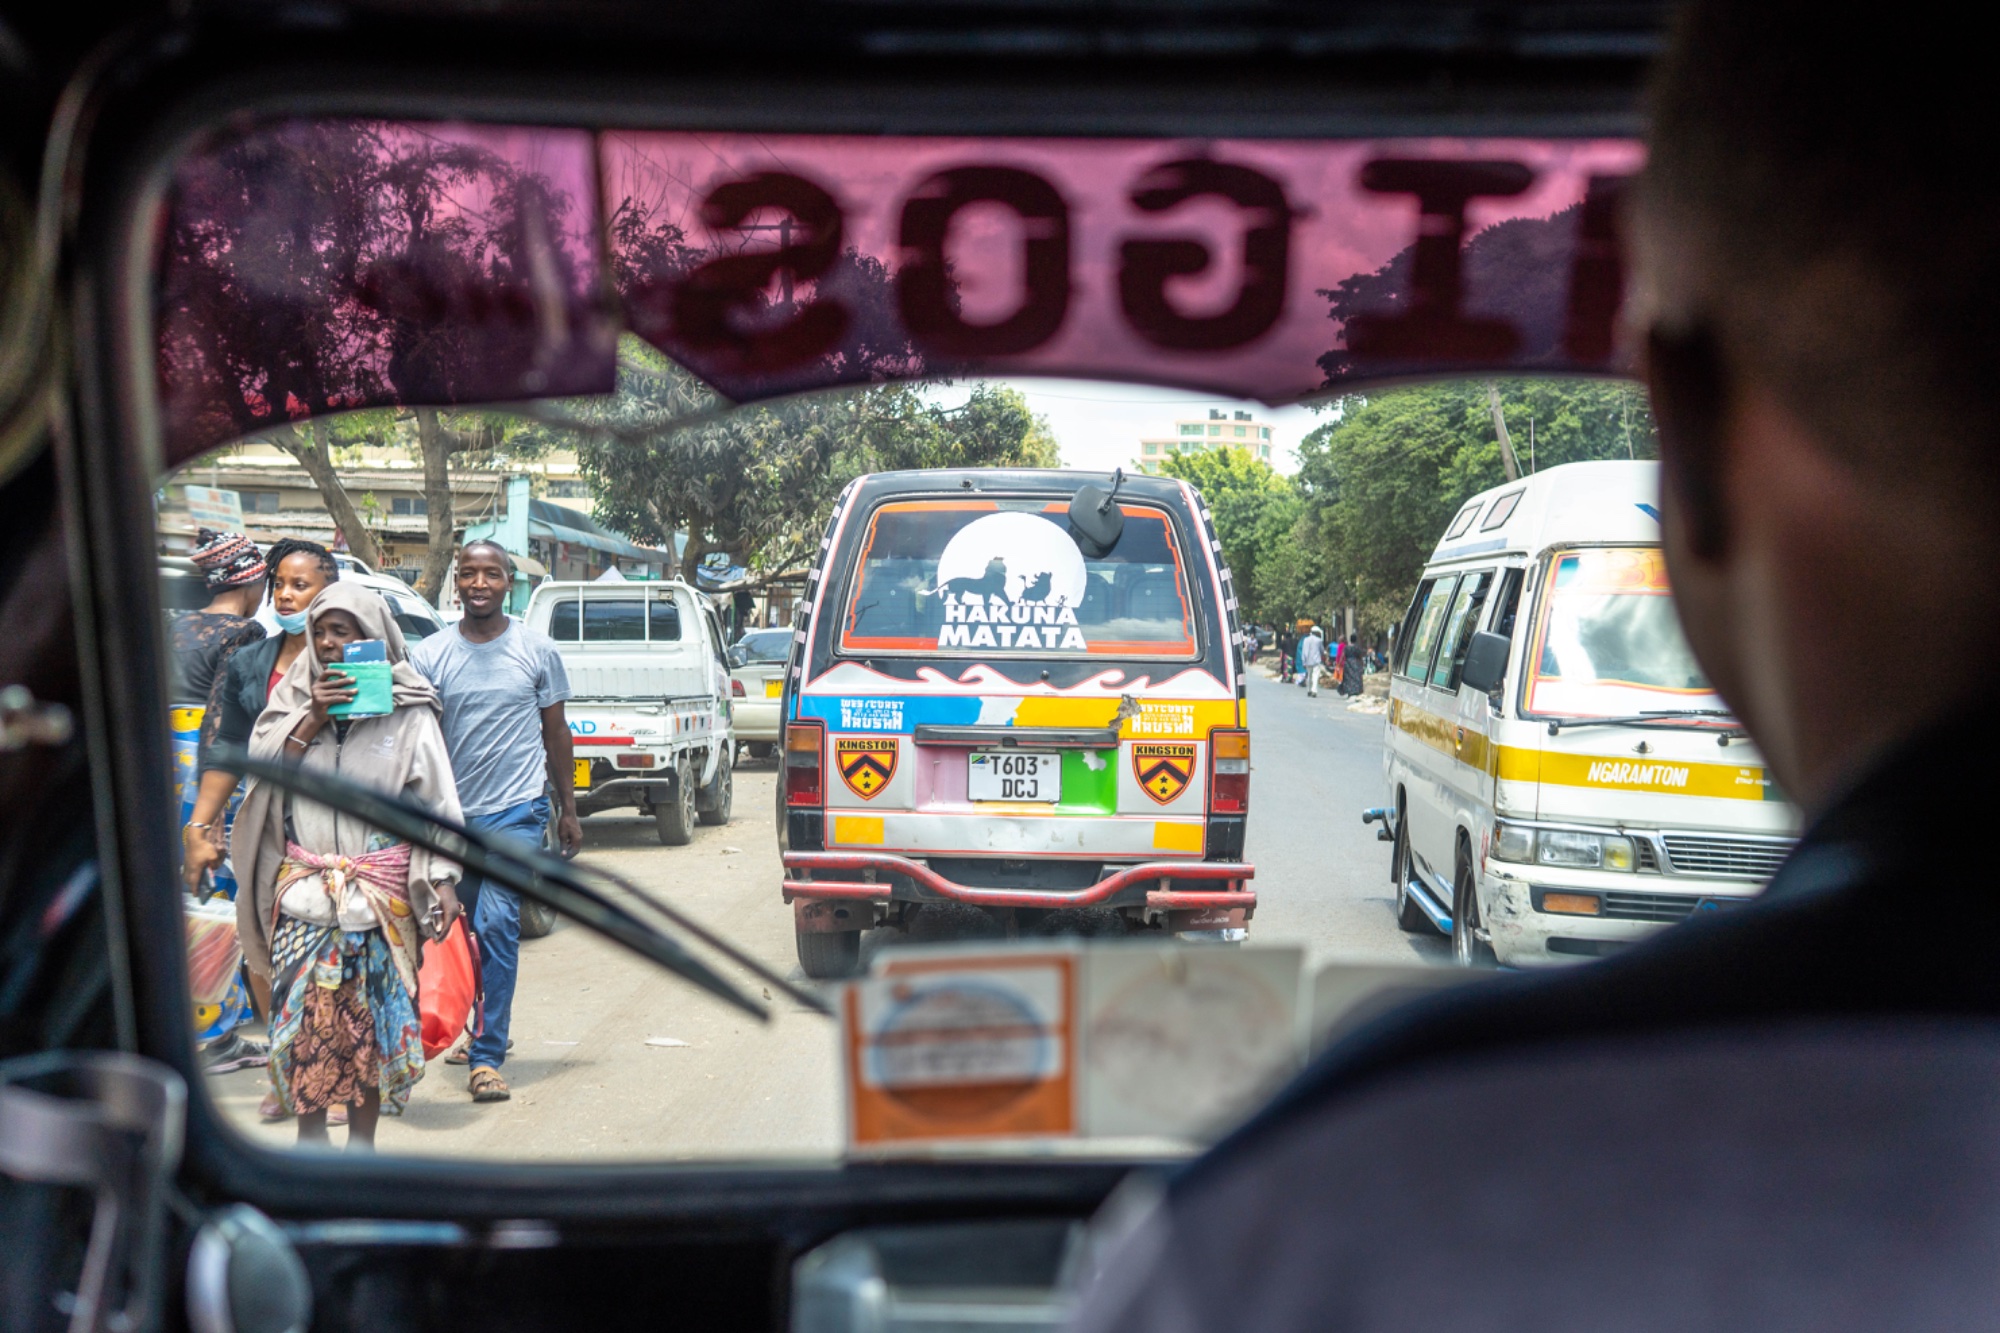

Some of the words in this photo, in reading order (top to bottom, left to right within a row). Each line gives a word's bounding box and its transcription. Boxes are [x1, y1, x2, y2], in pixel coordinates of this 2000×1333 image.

[944, 605, 1079, 625] HAKUNA
[938, 625, 1087, 649] MATATA
[839, 740, 896, 750] KINGSTON
[1135, 745, 1194, 755] KINGSTON
[990, 755, 1039, 775] T603
[1586, 761, 1690, 787] NGARAMTONI
[1001, 778, 1039, 798] DCJ
